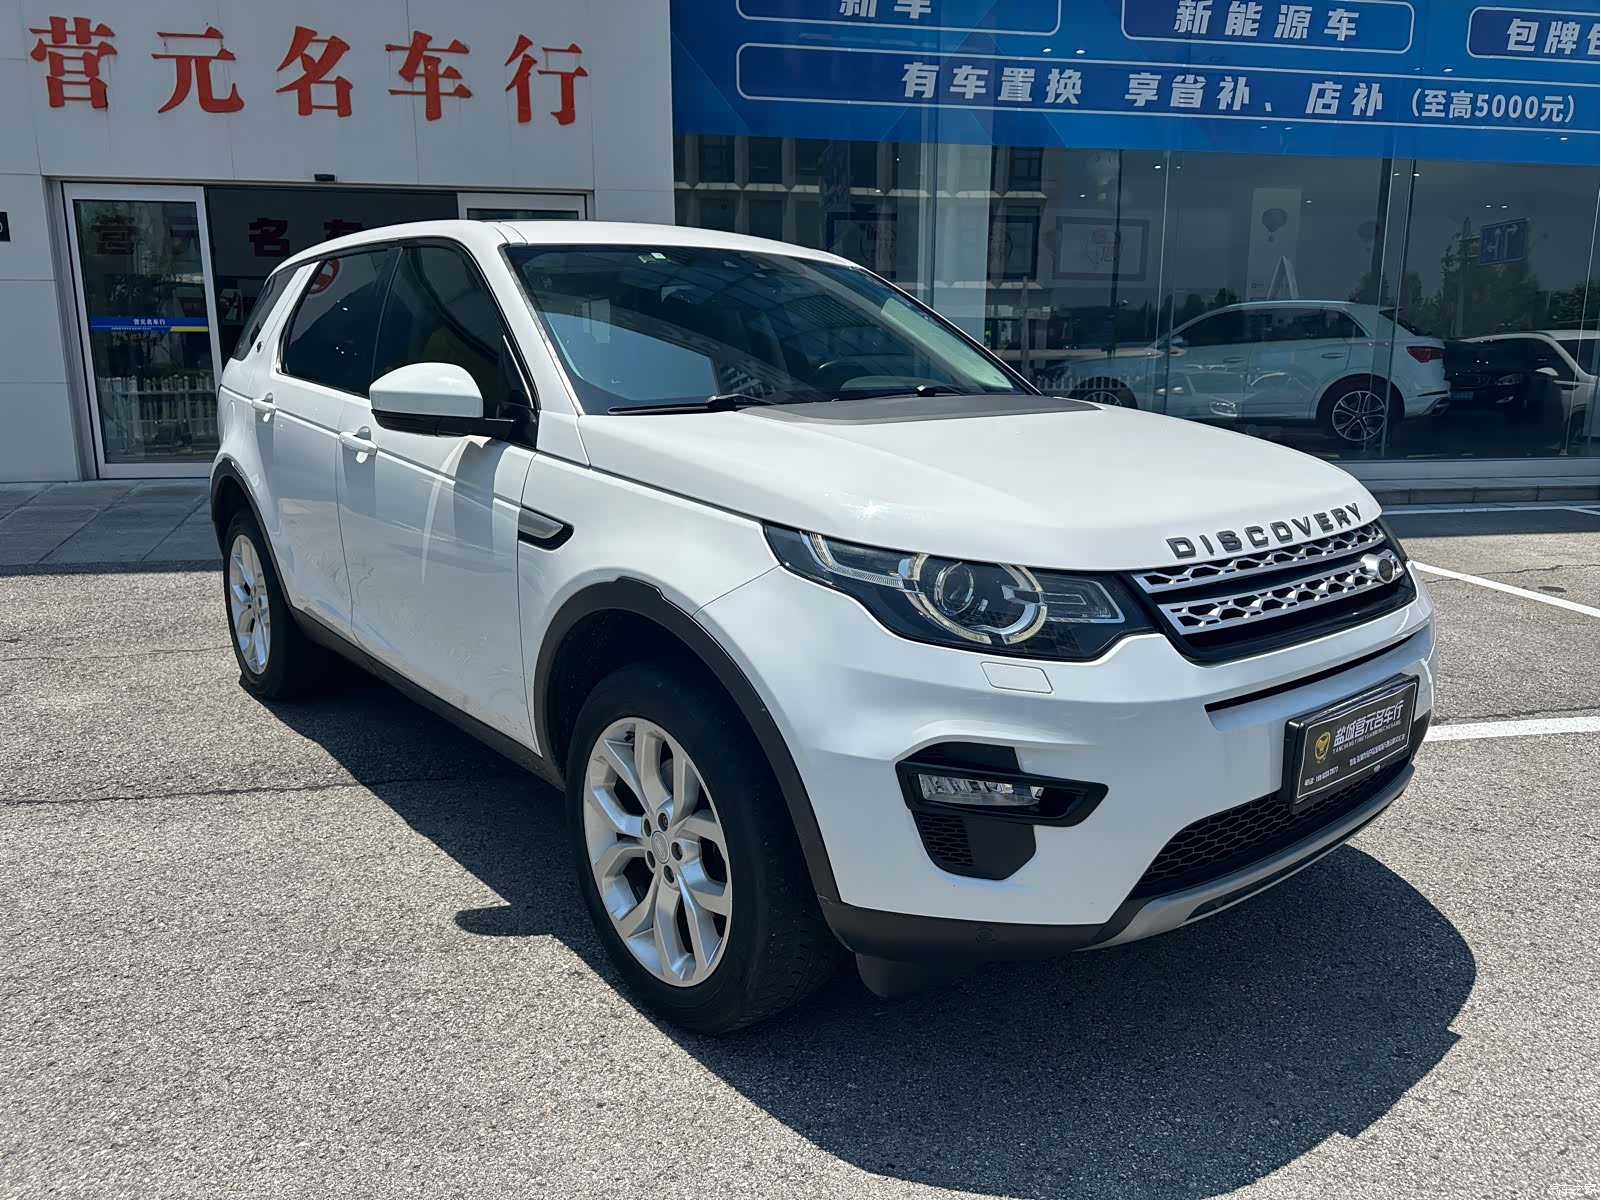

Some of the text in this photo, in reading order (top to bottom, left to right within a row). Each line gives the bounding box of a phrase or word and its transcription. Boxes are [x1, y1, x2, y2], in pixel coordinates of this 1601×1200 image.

[1173, 0, 1360, 42] 新能源车
[29, 15, 588, 126] 营元名车行
[901, 62, 1083, 105] 有车置换
[1166, 502, 1363, 559] DISCOVERY
[1333, 699, 1404, 748] 盐城营元名车行
